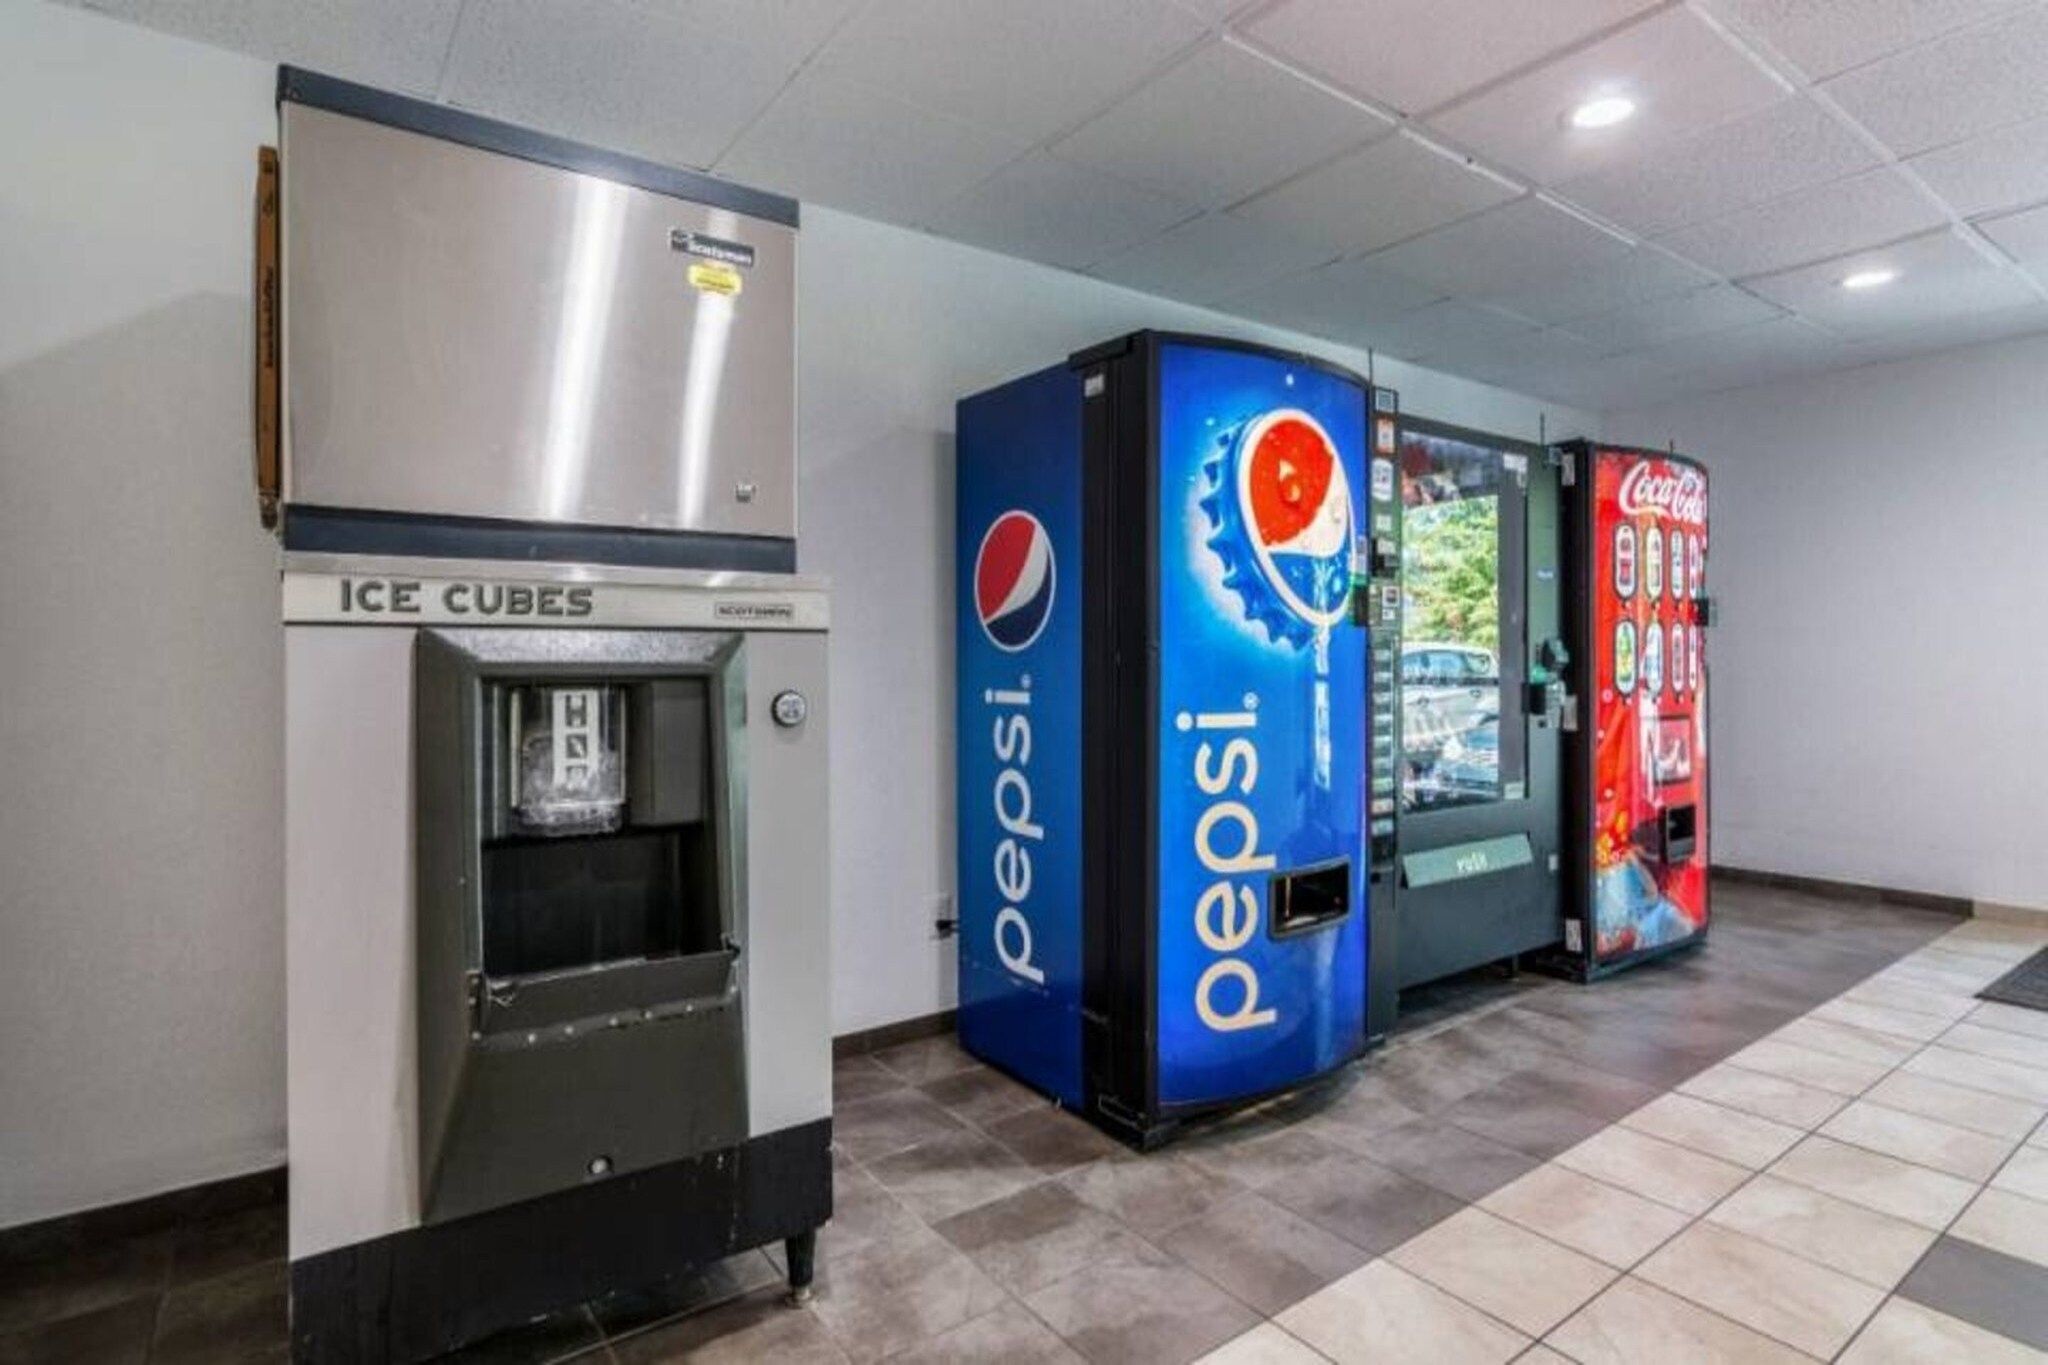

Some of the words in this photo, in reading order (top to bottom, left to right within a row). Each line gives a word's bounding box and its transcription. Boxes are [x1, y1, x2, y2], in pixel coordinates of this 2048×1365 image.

[340, 579, 421, 612] ICE
[441, 583, 593, 617] CUBES
[985, 688, 1044, 985] pepsi
[1177, 712, 1277, 1032] pepsi
